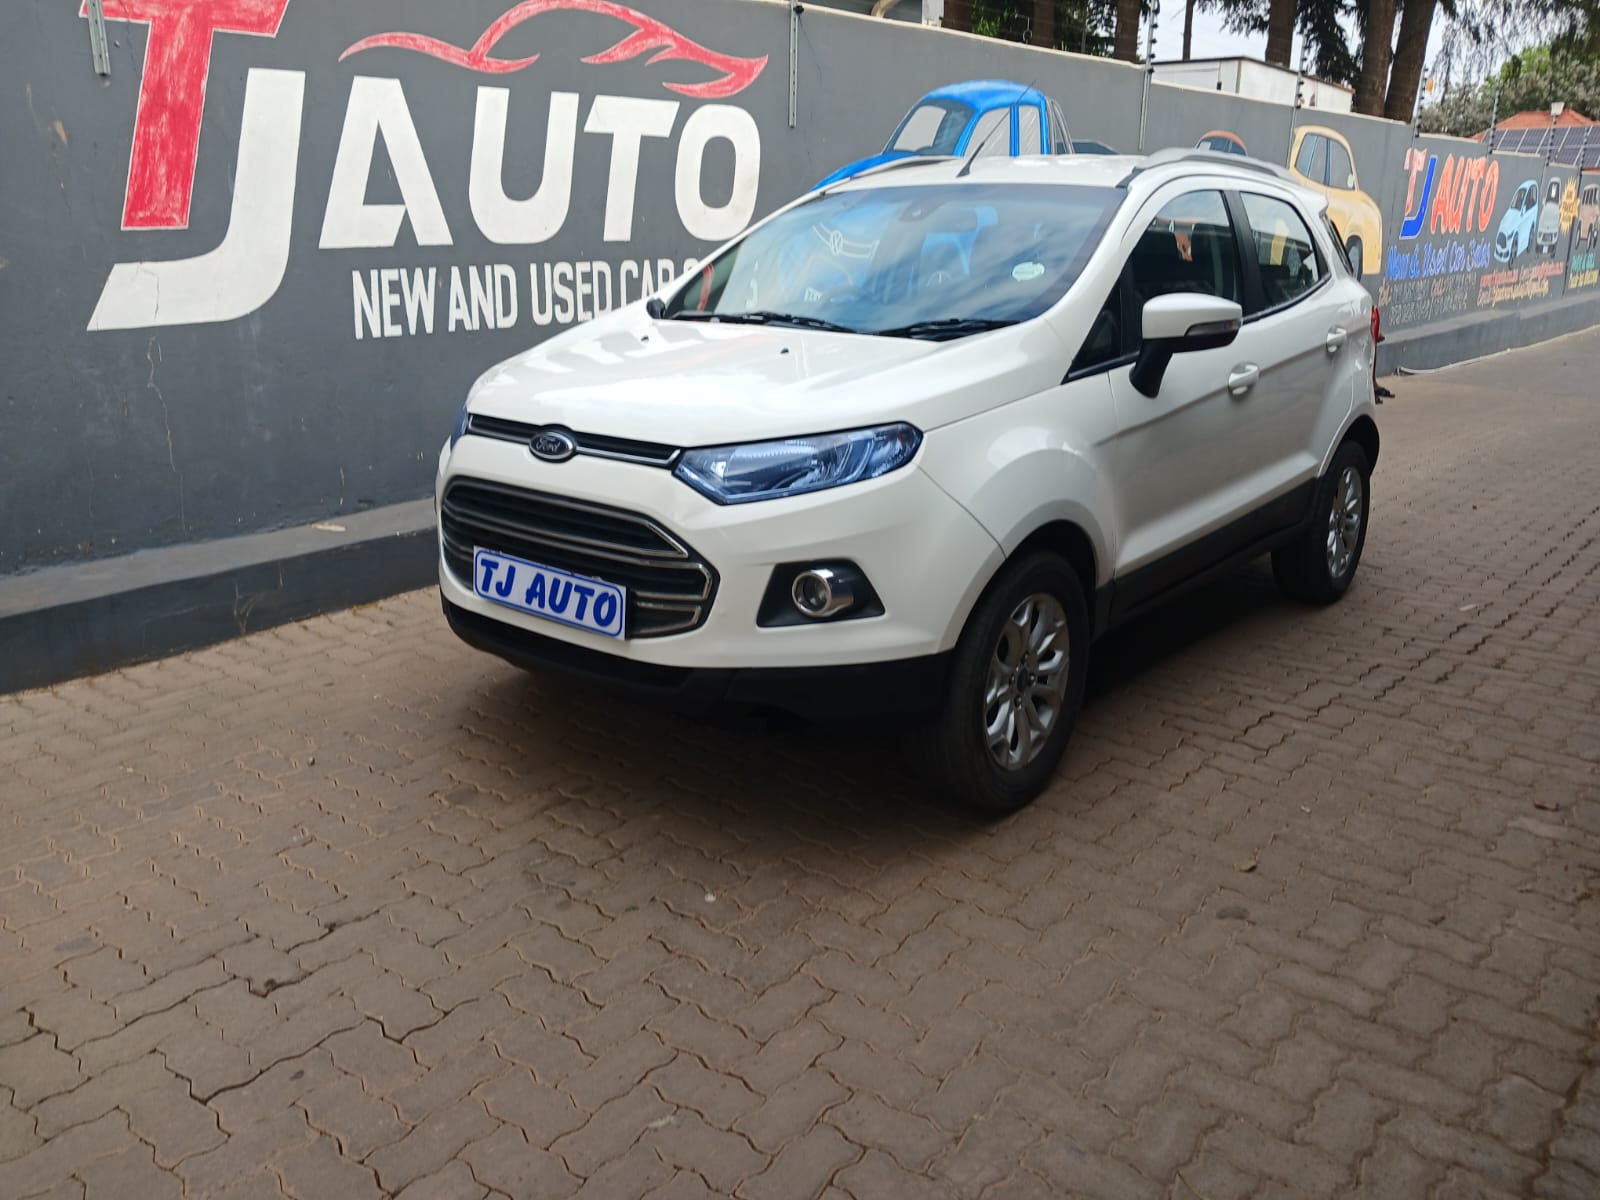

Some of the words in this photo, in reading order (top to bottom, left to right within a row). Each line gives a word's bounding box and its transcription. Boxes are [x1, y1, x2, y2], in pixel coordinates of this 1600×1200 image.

[318, 75, 761, 249] AUTO
[1399, 147, 1438, 240] TJ
[1430, 152, 1499, 235] AUTO
[352, 267, 436, 340] NEW
[448, 263, 518, 332] AND
[529, 260, 612, 325] USED
[480, 558, 517, 598] TJ
[525, 572, 618, 629] AUTO
